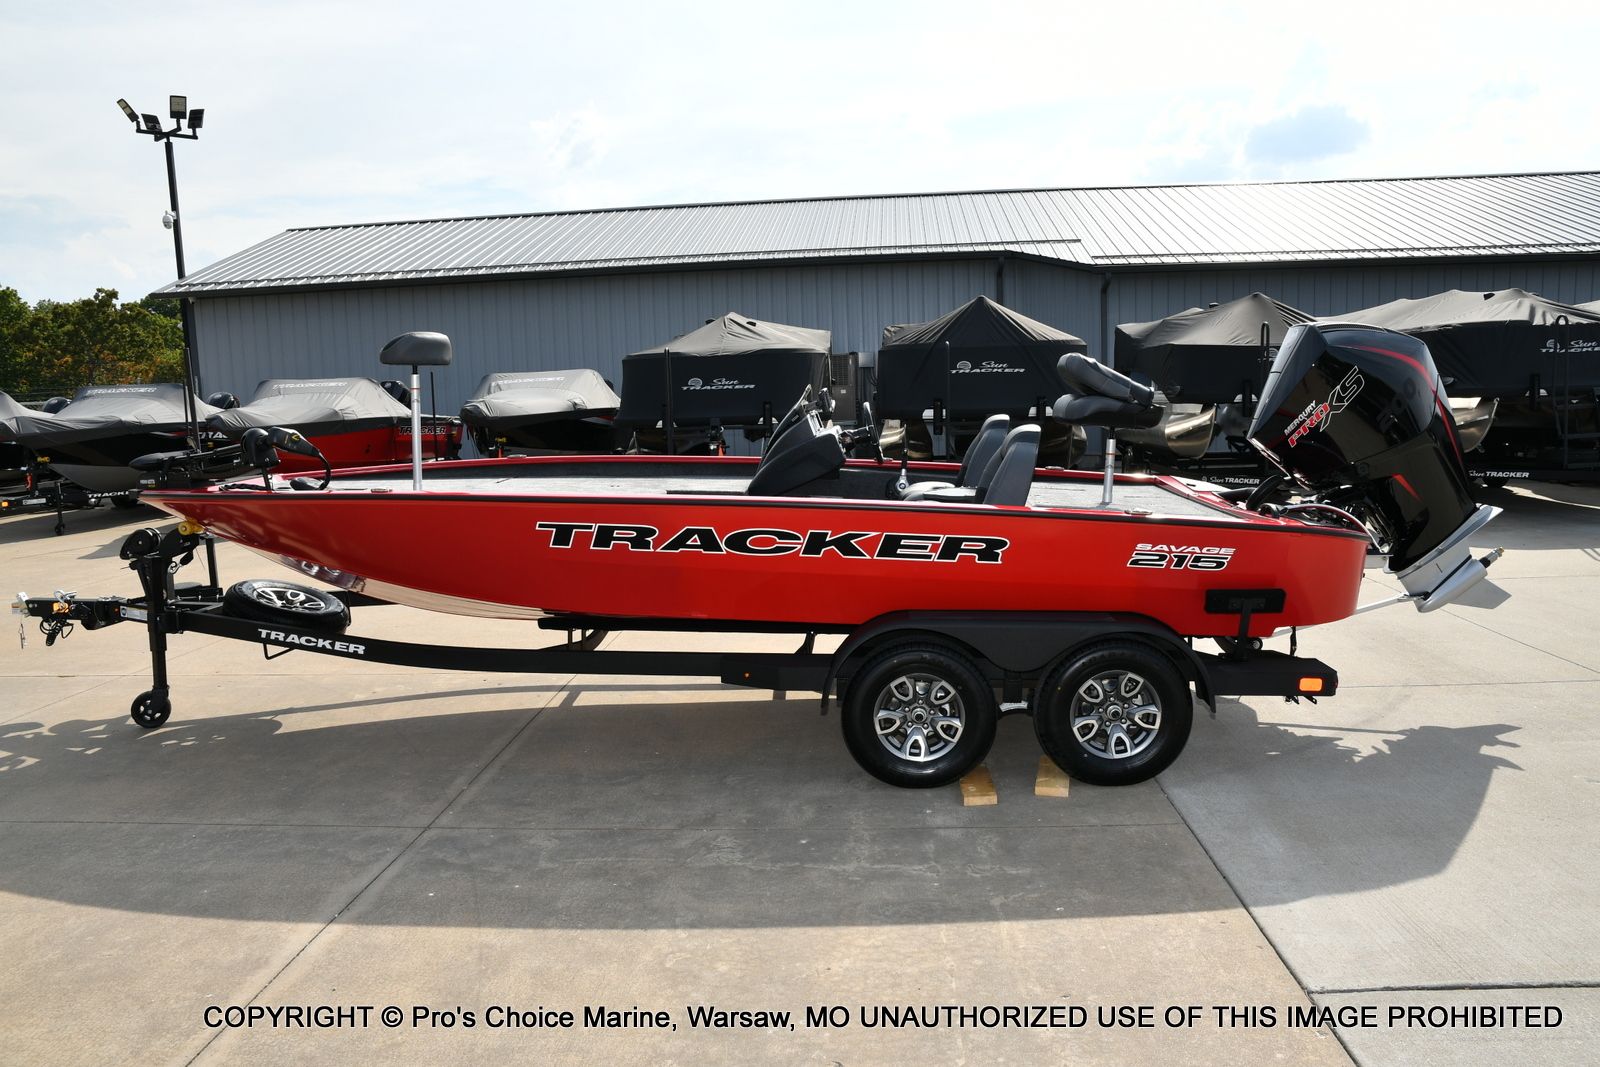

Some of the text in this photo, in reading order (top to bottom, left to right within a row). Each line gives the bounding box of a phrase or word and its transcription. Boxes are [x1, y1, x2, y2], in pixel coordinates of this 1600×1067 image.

[980, 360, 1009, 368] Sun
[711, 377, 740, 386] Sun
[1284, 400, 1318, 436] MERCURY
[399, 425, 447, 435] TRCKER
[1224, 477, 1260, 485] TRACKER
[535, 521, 1010, 565] TRACKER
[1135, 543, 1236, 555] SAVAGE
[1126, 551, 1232, 571] 215
[257, 628, 366, 655] TRACKER
